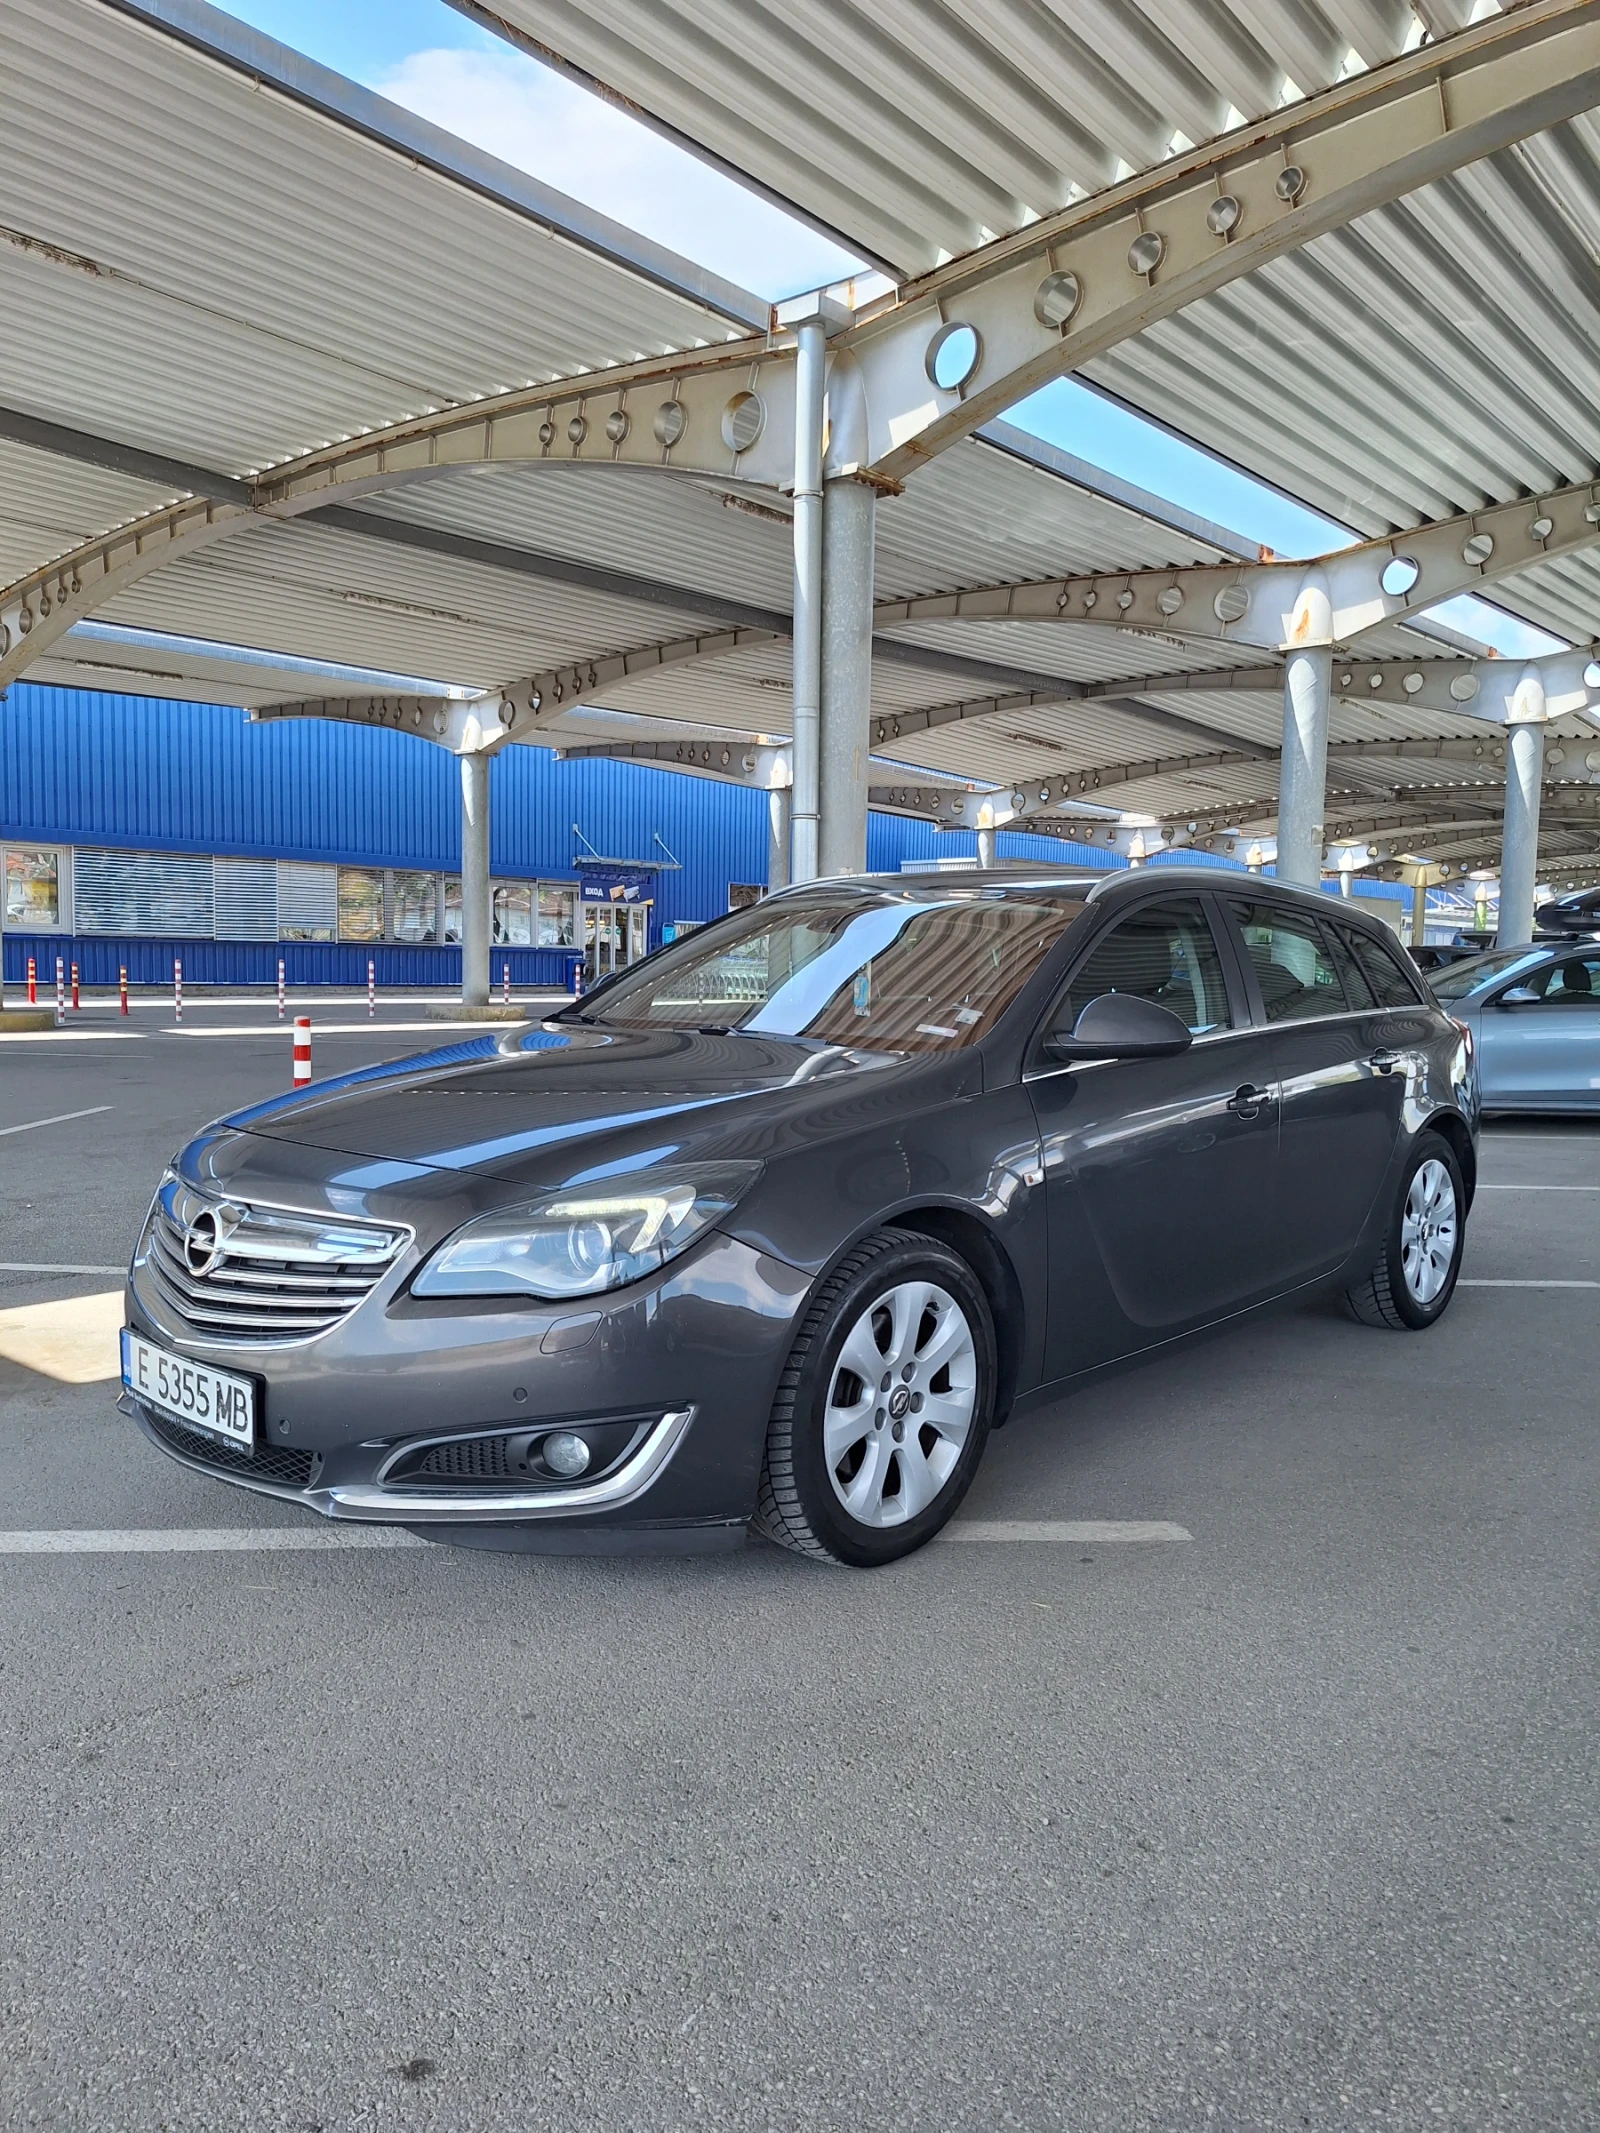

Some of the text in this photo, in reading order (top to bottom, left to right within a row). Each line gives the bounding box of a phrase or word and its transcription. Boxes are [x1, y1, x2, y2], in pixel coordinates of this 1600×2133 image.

[585, 887, 604, 897] ВХОД
[138, 1346, 149, 1390] E
[158, 1357, 210, 1417] 5355
[215, 1381, 248, 1432] MB
[229, 1440, 245, 1452] OPEL
